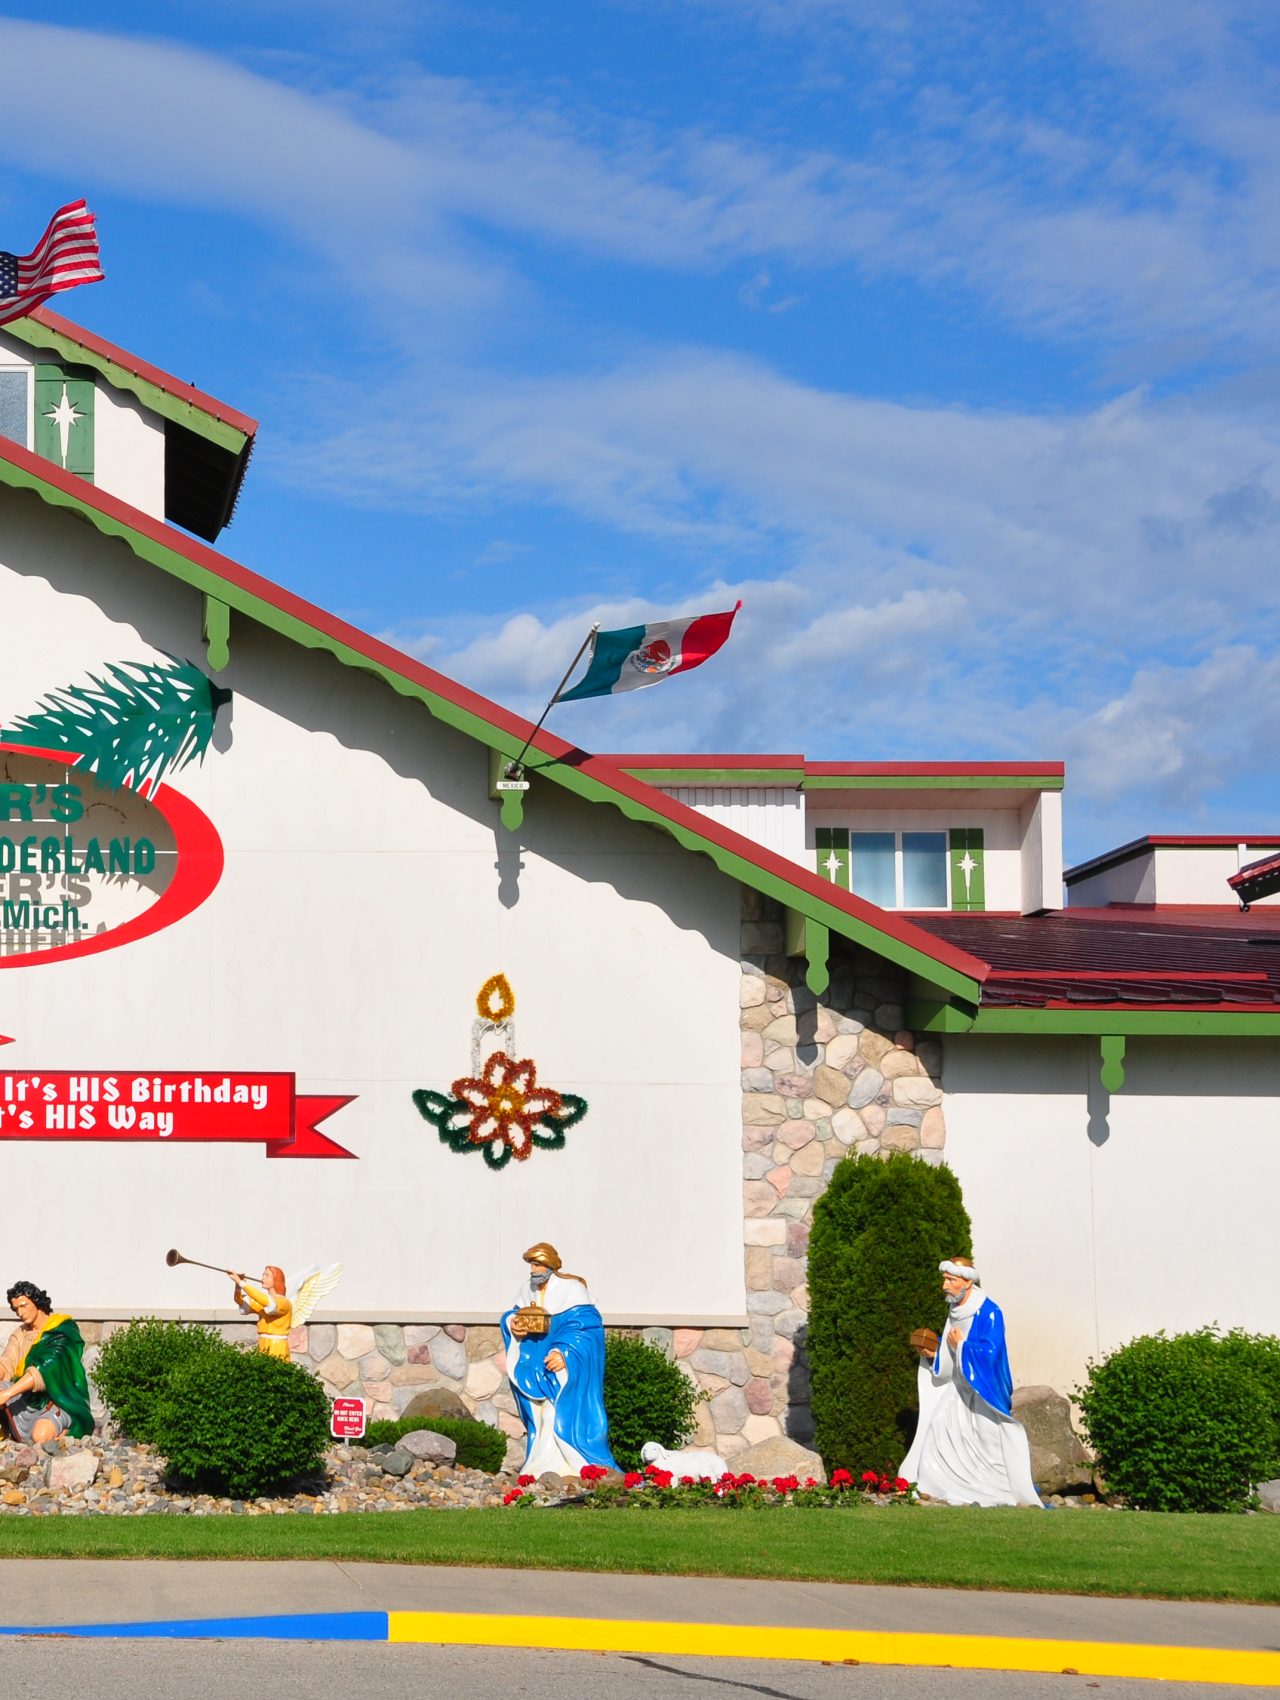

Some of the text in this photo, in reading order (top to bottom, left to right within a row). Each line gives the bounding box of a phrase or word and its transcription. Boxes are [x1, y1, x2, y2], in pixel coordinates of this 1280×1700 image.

[2, 900, 88, 930] Mich.
[4, 1076, 268, 1110] It's HIS Birthday
[45, 1104, 97, 1129] HIS
[108, 1104, 174, 1137] Way
